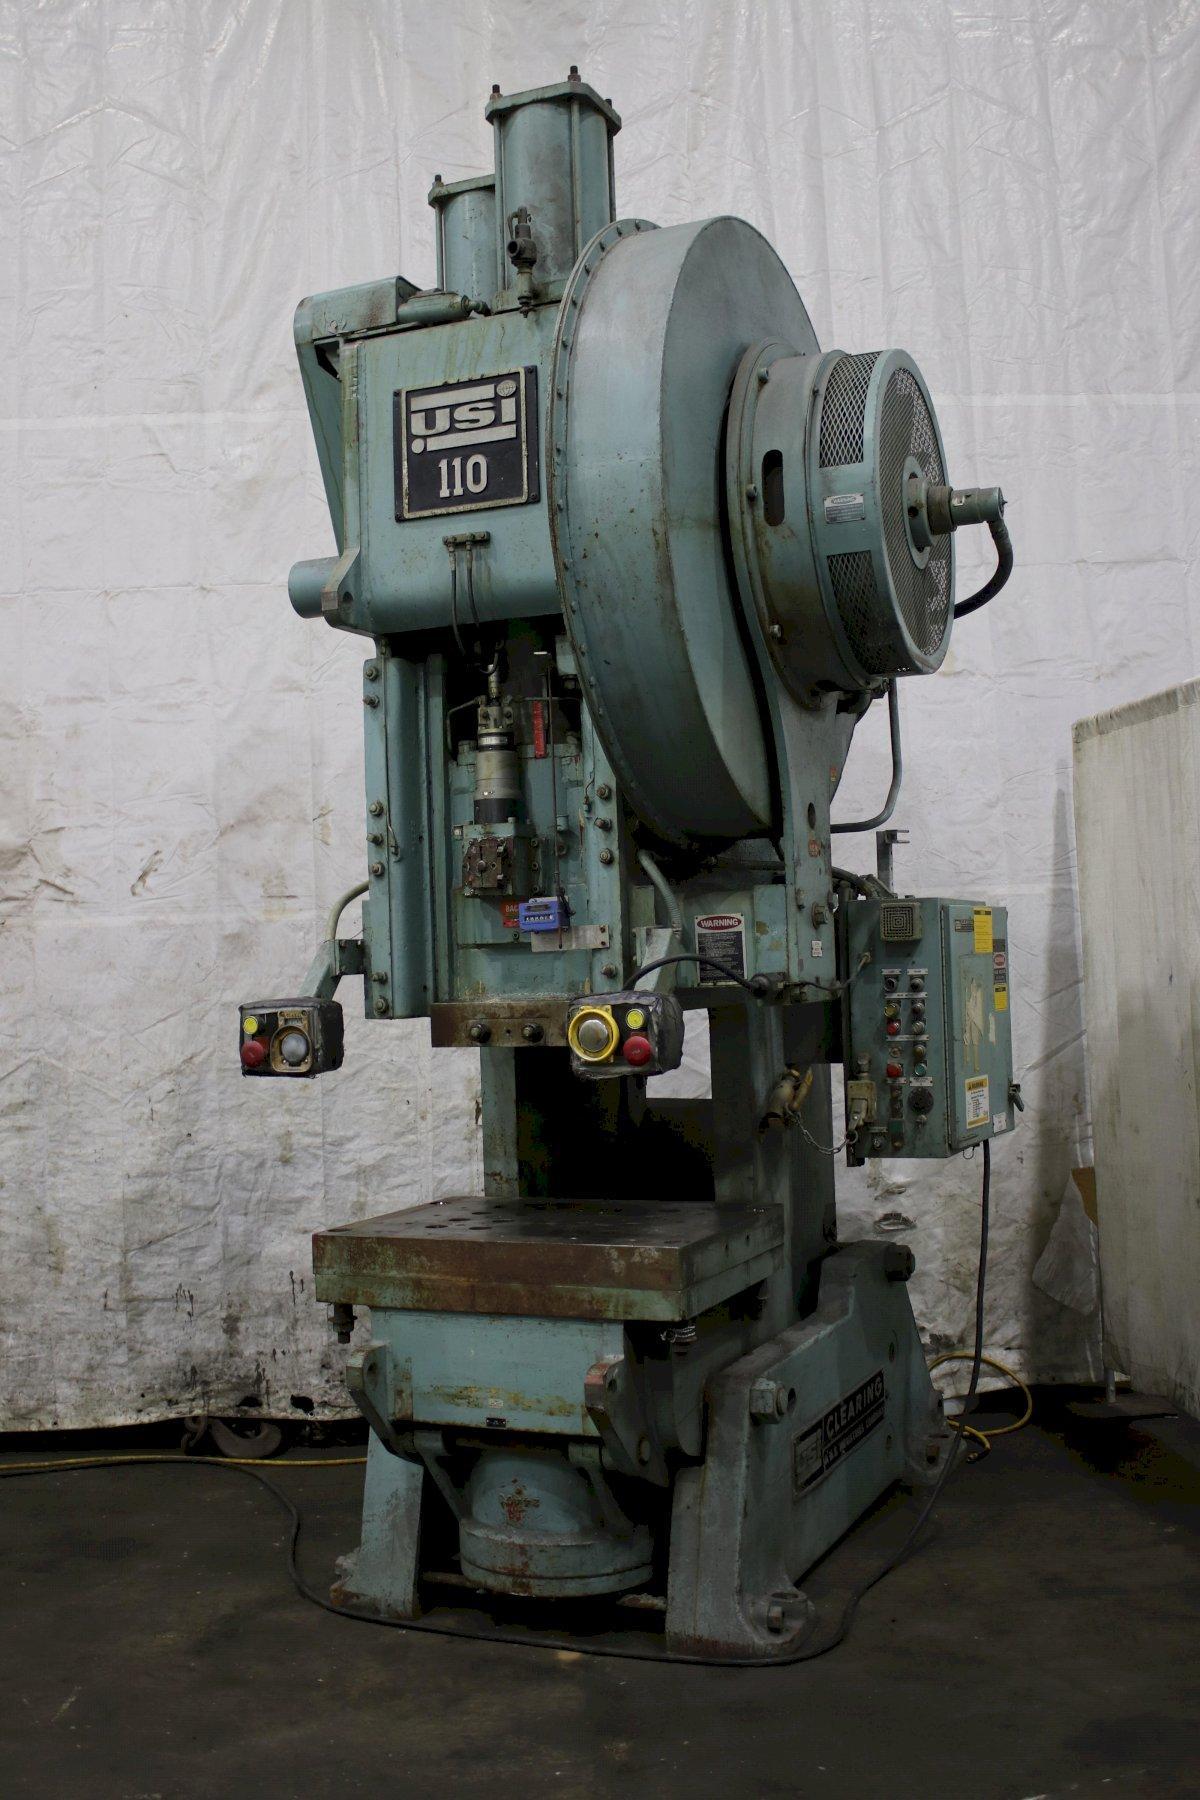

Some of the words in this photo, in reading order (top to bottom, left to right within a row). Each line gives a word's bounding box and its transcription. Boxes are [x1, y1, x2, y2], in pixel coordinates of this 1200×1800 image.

[438, 454, 488, 498] 110
[700, 919, 739, 928] WARNING
[826, 1376, 883, 1438] CLEARING
